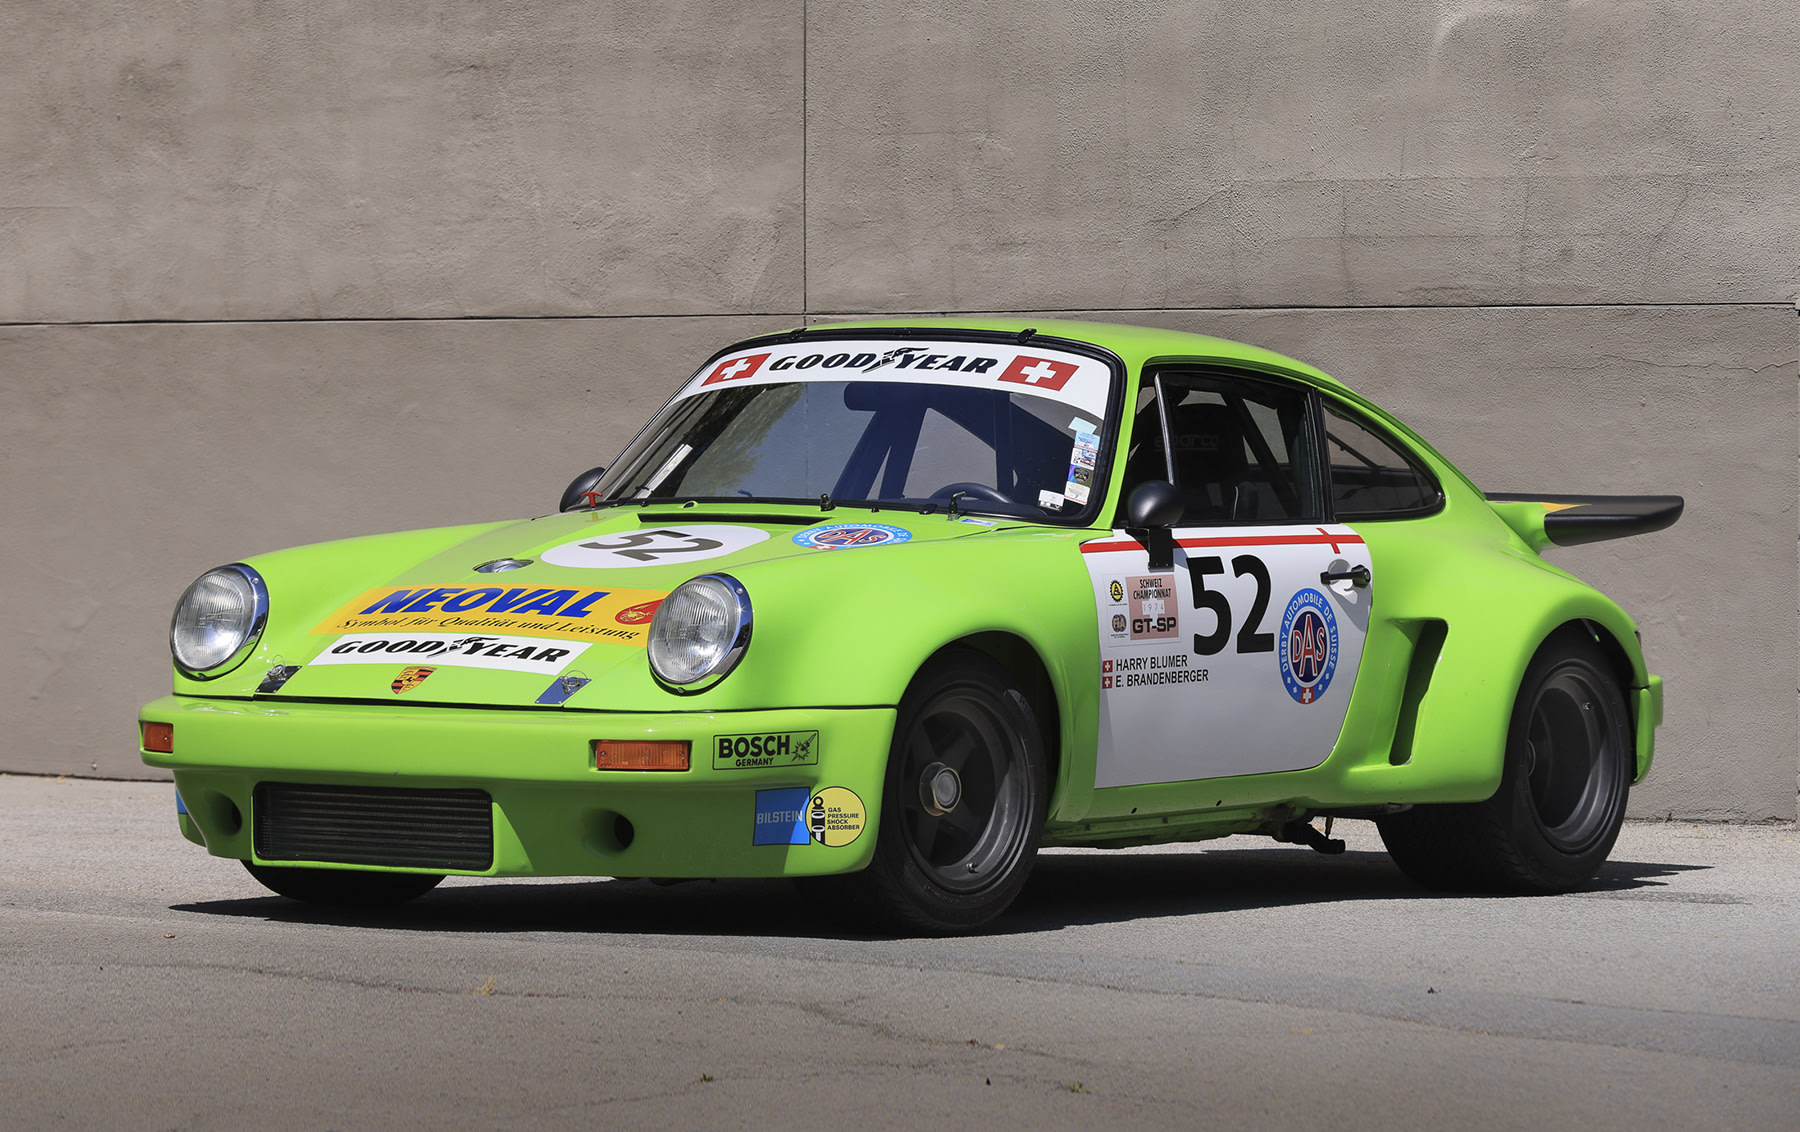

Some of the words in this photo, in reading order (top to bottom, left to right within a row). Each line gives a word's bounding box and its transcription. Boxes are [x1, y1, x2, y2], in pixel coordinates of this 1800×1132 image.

[768, 352, 877, 371] GOOD
[894, 353, 999, 374] YEAR
[1153, 433, 1221, 448] sarco
[577, 529, 724, 562] 52
[818, 528, 888, 545] DAS
[1133, 588, 1172, 600] CHAMPIONNAT
[1139, 578, 1163, 589] SCHWEIZ
[357, 587, 612, 618] NEOVAL
[1185, 554, 1275, 656] 52
[1284, 593, 1323, 629] AUTOMOBILE
[1132, 616, 1177, 634] GT-SP
[1323, 605, 1334, 623] DE
[337, 617, 400, 629] Symbol
[400, 616, 431, 628] für
[438, 616, 519, 631] Qualität
[518, 619, 563, 632] und
[562, 621, 640, 641] Leistung
[330, 639, 446, 656] GOOD
[462, 640, 572, 663] YEAR
[1281, 632, 1289, 672] DERBY
[1292, 613, 1325, 677] DAS
[1328, 626, 1337, 669] SUISSE
[1115, 656, 1148, 672] HARRY
[1150, 654, 1188, 669] BLUMER
[1115, 674, 1124, 688] E.
[1126, 669, 1209, 687] BRANDENBERGER
[718, 735, 790, 758] BOSCH
[735, 757, 774, 767] GERMANY
[756, 810, 803, 825] BILSTEIN
